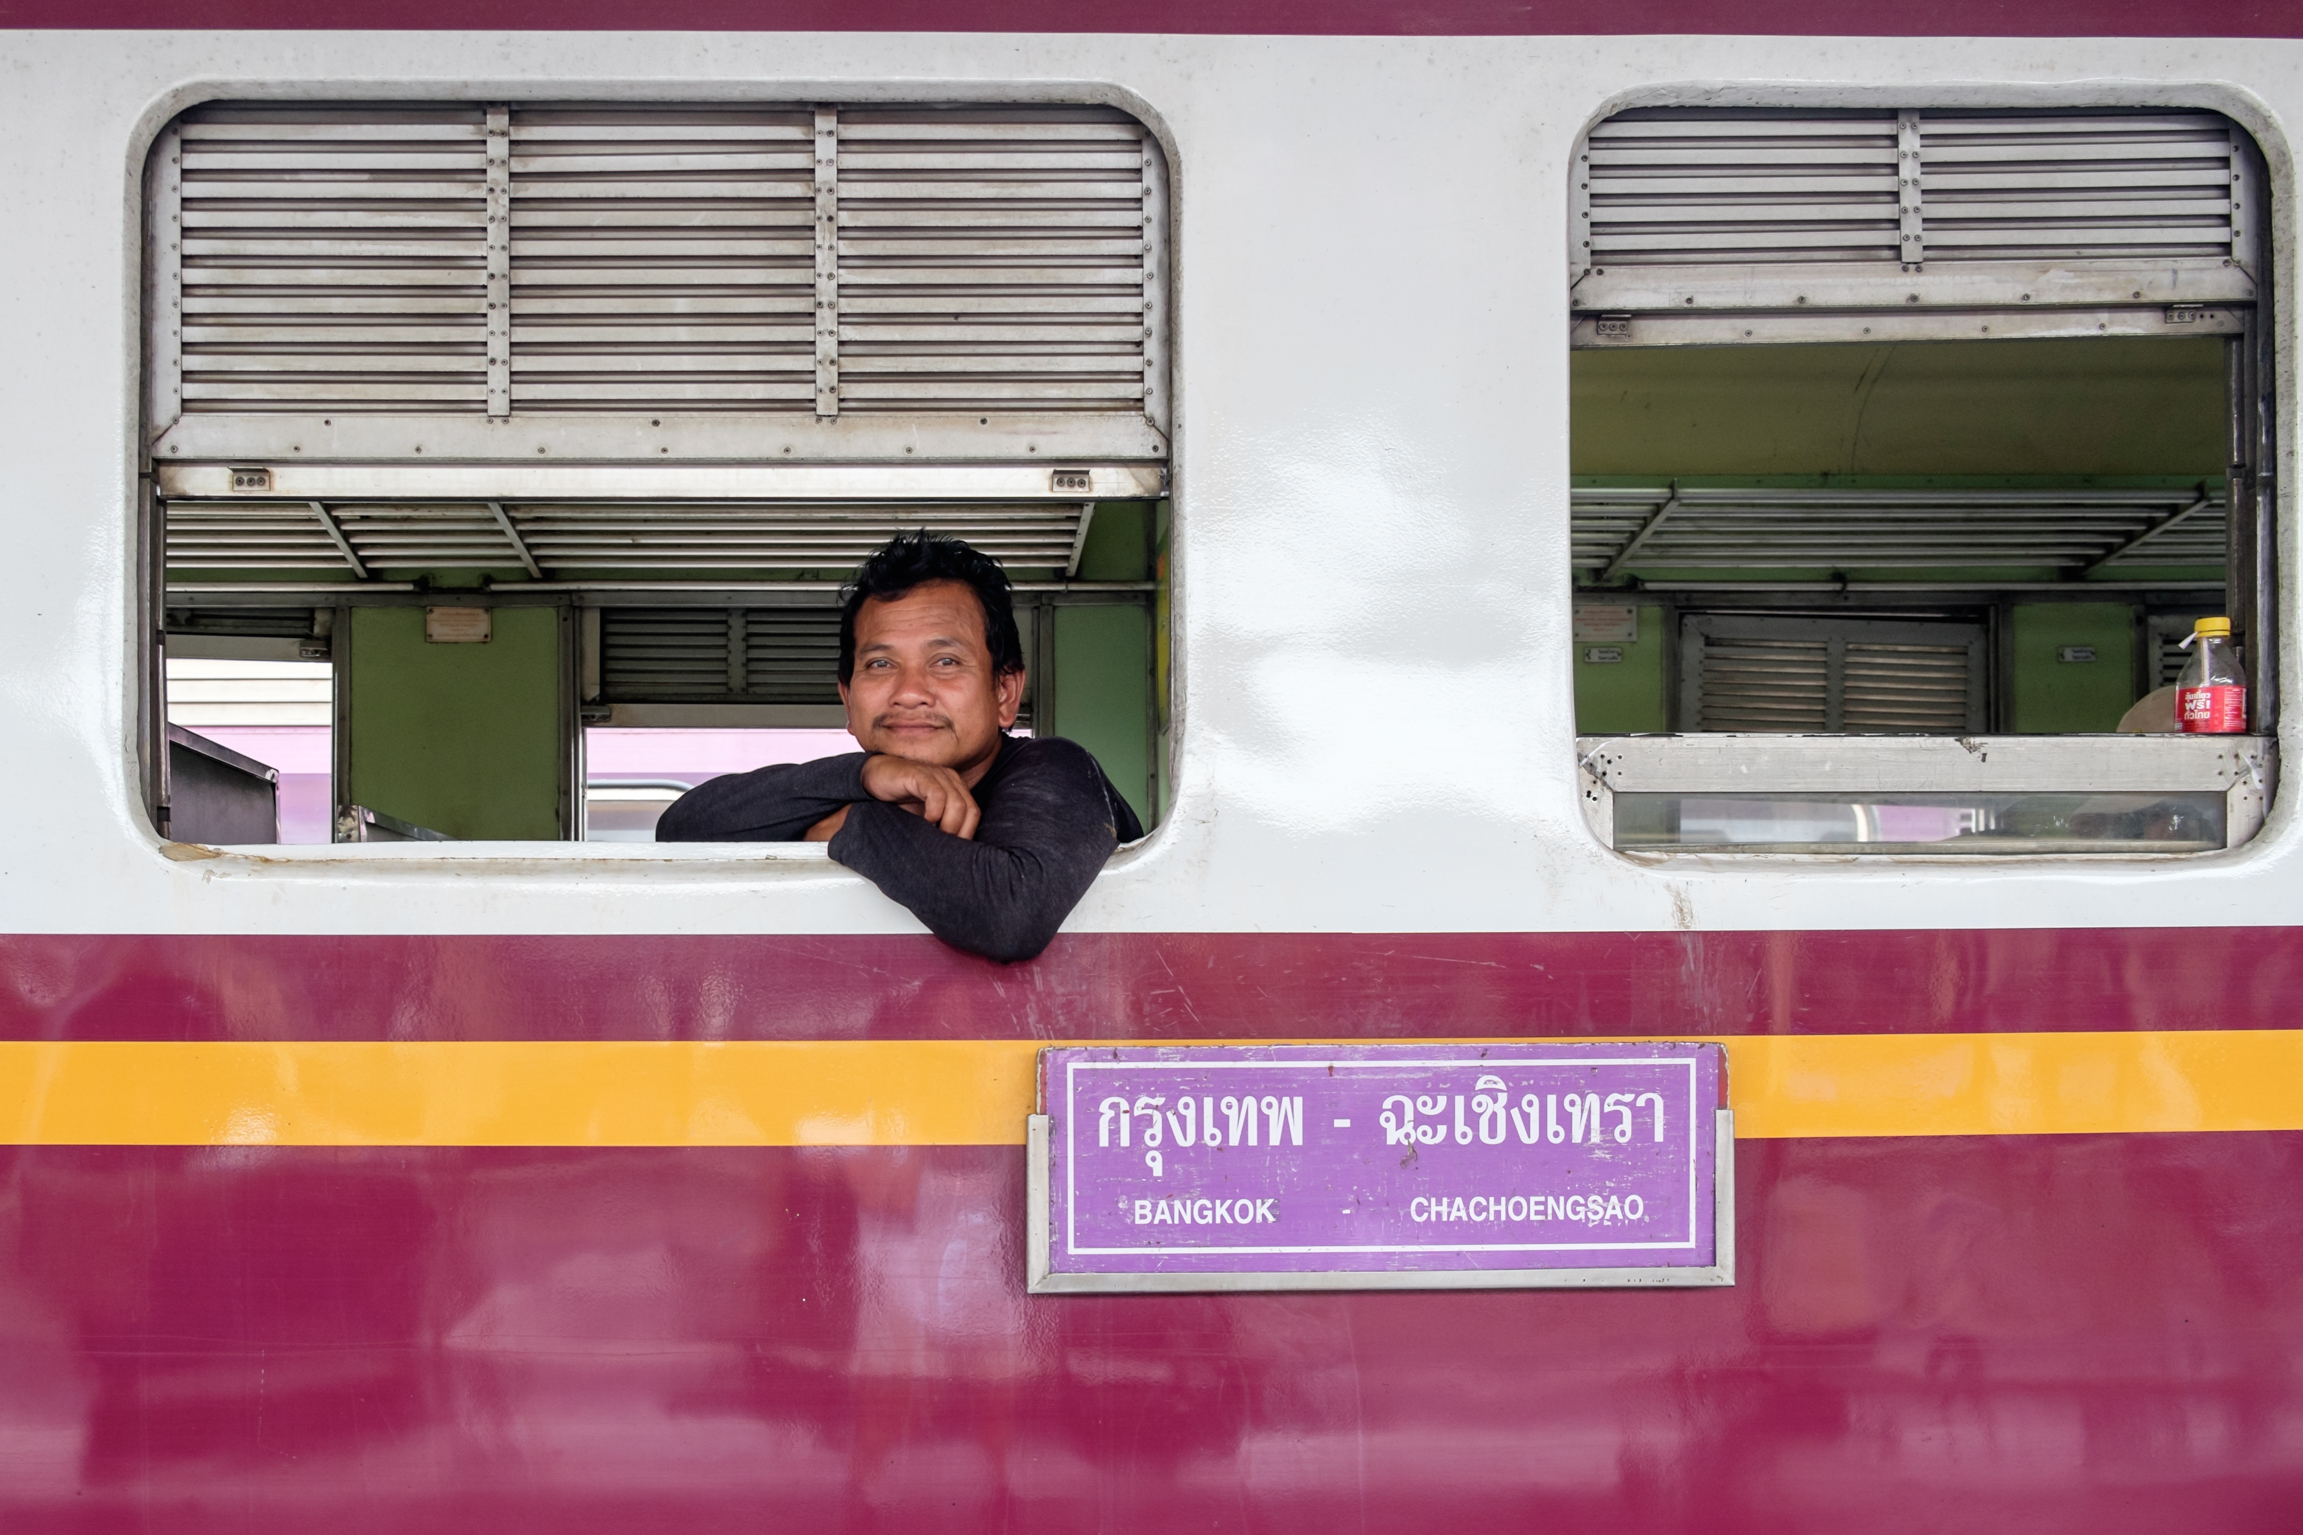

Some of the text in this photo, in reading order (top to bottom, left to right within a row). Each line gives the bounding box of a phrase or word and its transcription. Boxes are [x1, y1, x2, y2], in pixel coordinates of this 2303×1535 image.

[2185, 698, 2211, 710] ฟรี!
[1098, 1096, 1303, 1177] กรุงเทพ
[1379, 1074, 1664, 1145] ฉะเชิงเทรา
[1134, 1199, 1277, 1225] BANGKOK
[1410, 1194, 1644, 1222] CHACHOENGSAO
